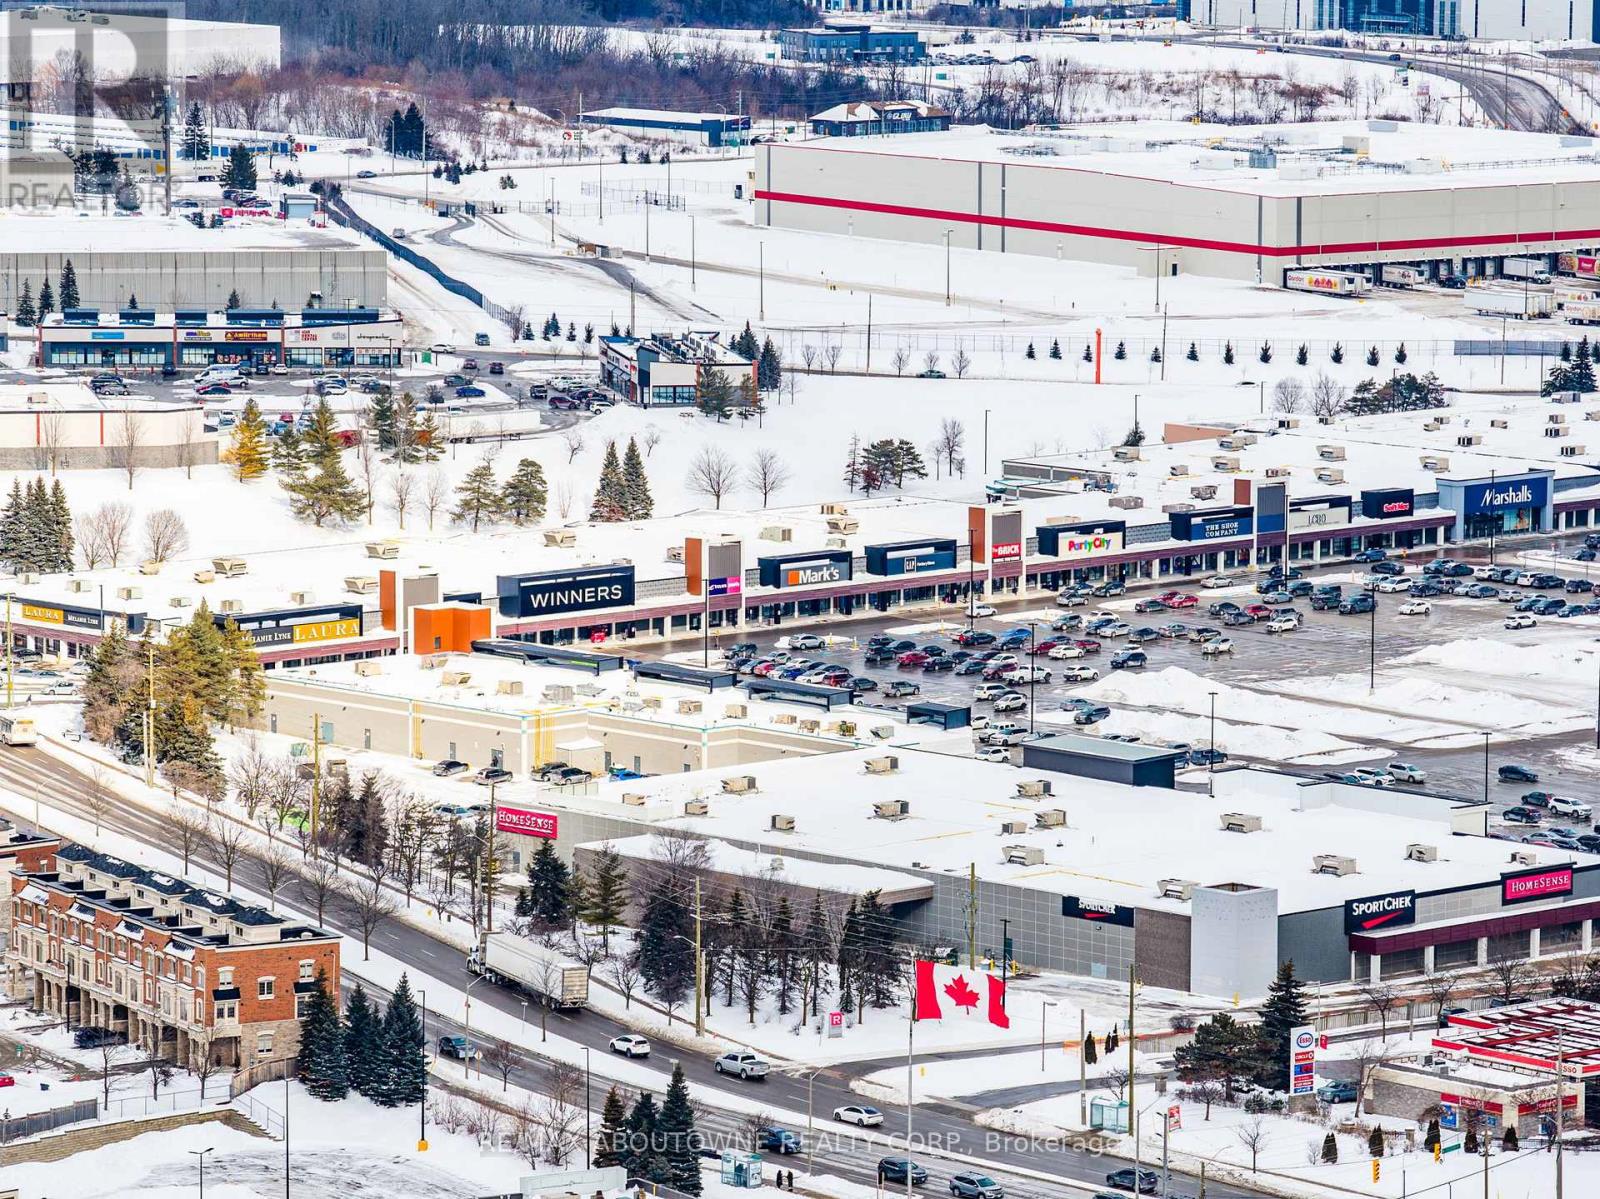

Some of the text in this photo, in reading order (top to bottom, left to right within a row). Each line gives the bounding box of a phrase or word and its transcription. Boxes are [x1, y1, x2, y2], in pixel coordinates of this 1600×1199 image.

[1481, 485, 1532, 506] Marshalls
[1205, 522, 1239, 532] THE SHOE
[1205, 528, 1238, 538] COMPANY
[800, 567, 840, 584] Mark's
[530, 584, 622, 609] WINNERS
[24, 606, 60, 620] LAURA
[241, 633, 273, 643] MLANIE
[294, 621, 360, 641] LAURA
